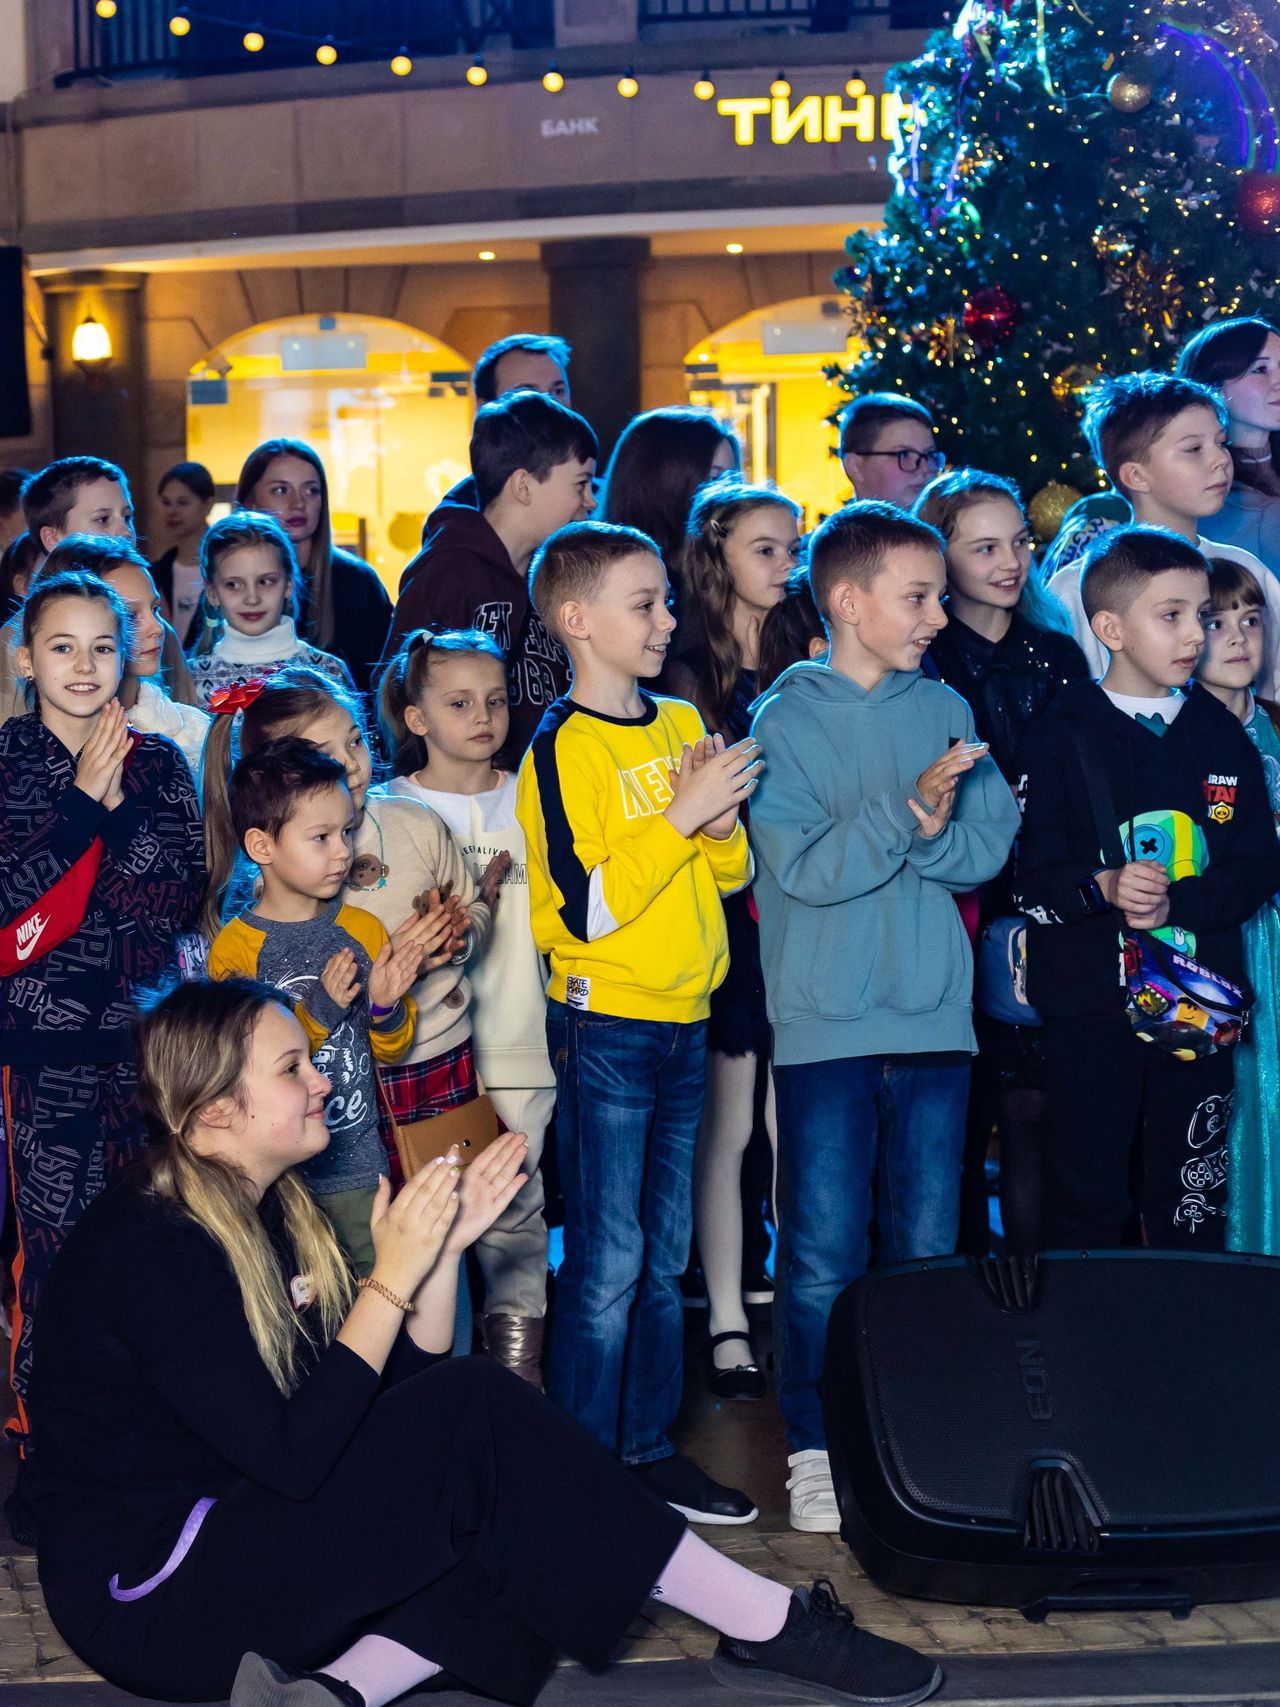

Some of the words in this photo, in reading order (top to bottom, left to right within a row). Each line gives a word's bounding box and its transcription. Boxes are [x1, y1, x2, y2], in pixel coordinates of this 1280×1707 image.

[540, 117, 600, 138] БАНК
[16, 912, 44, 946] NIKE
[1171, 954, 1244, 1000] ROBLOX
